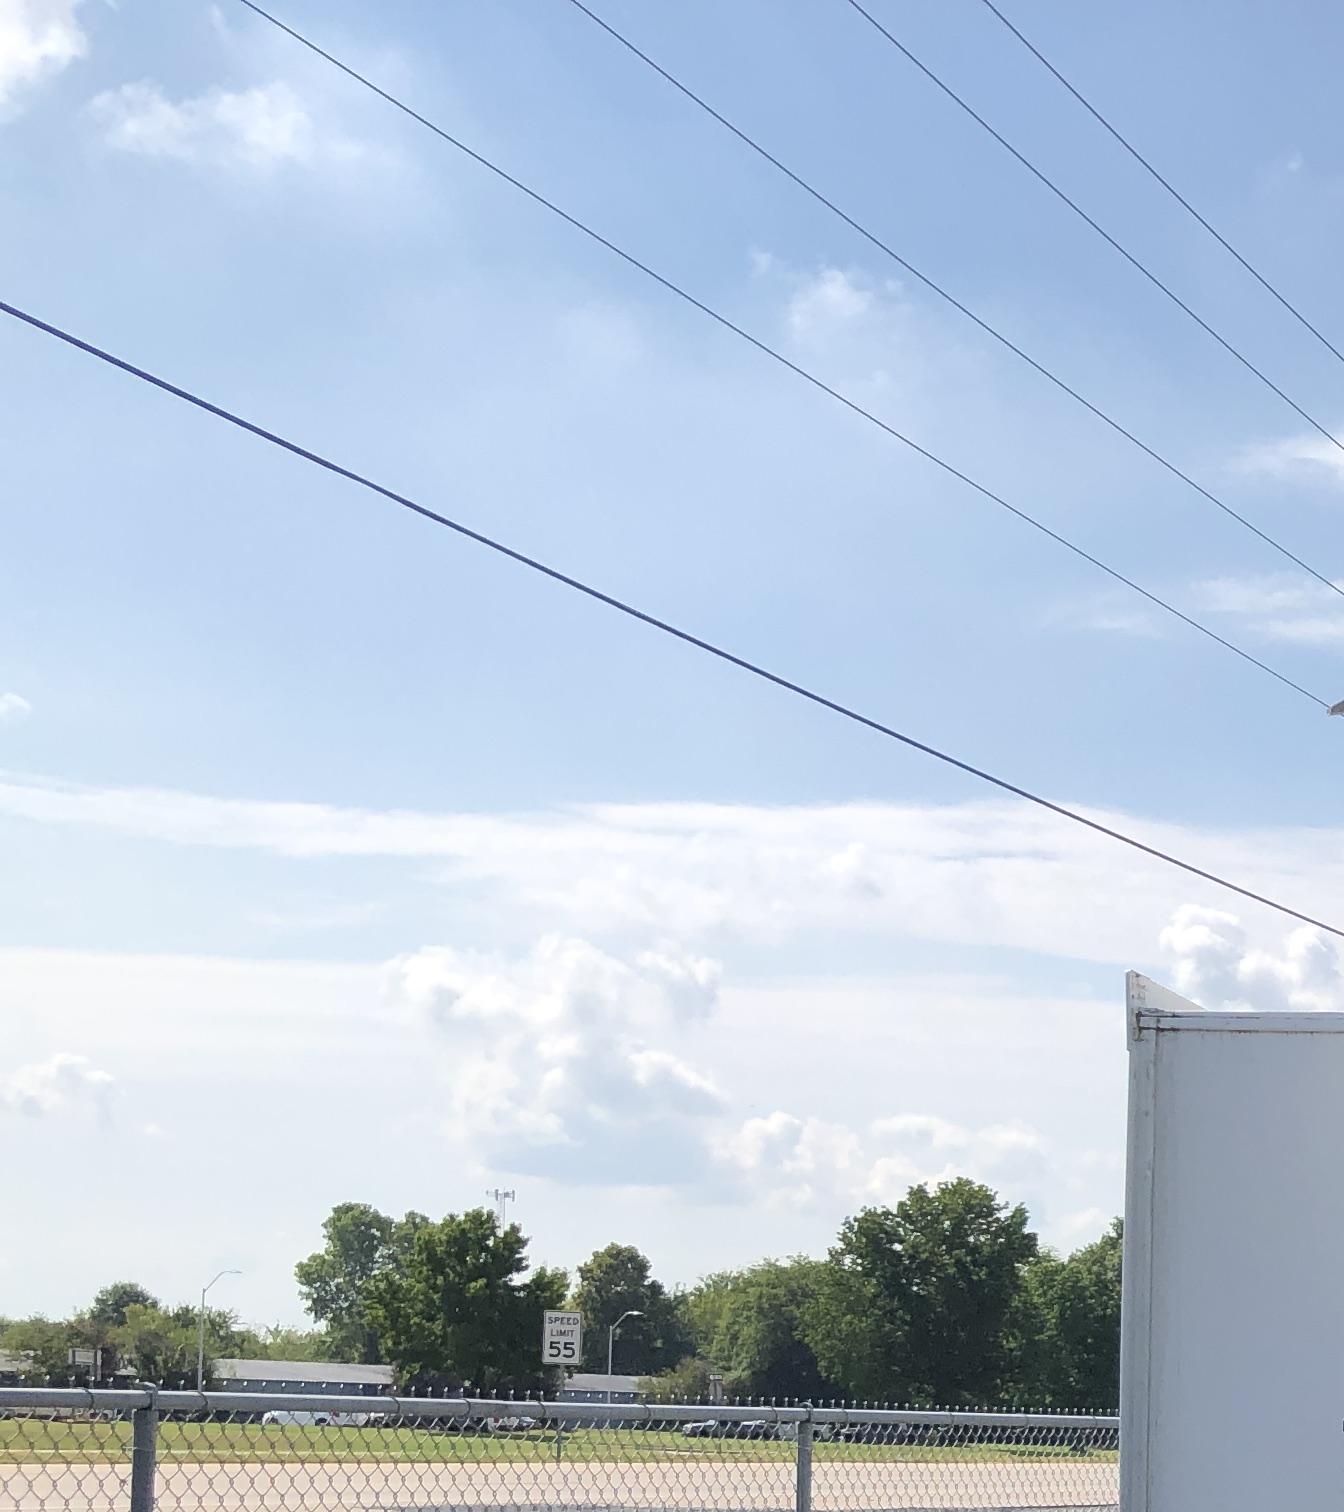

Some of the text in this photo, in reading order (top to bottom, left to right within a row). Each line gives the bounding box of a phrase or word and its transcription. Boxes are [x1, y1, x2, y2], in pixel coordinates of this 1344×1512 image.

[547, 1316, 579, 1326] SPEED
[550, 1329, 575, 1338] LIMIT
[548, 1341, 576, 1358] 55
